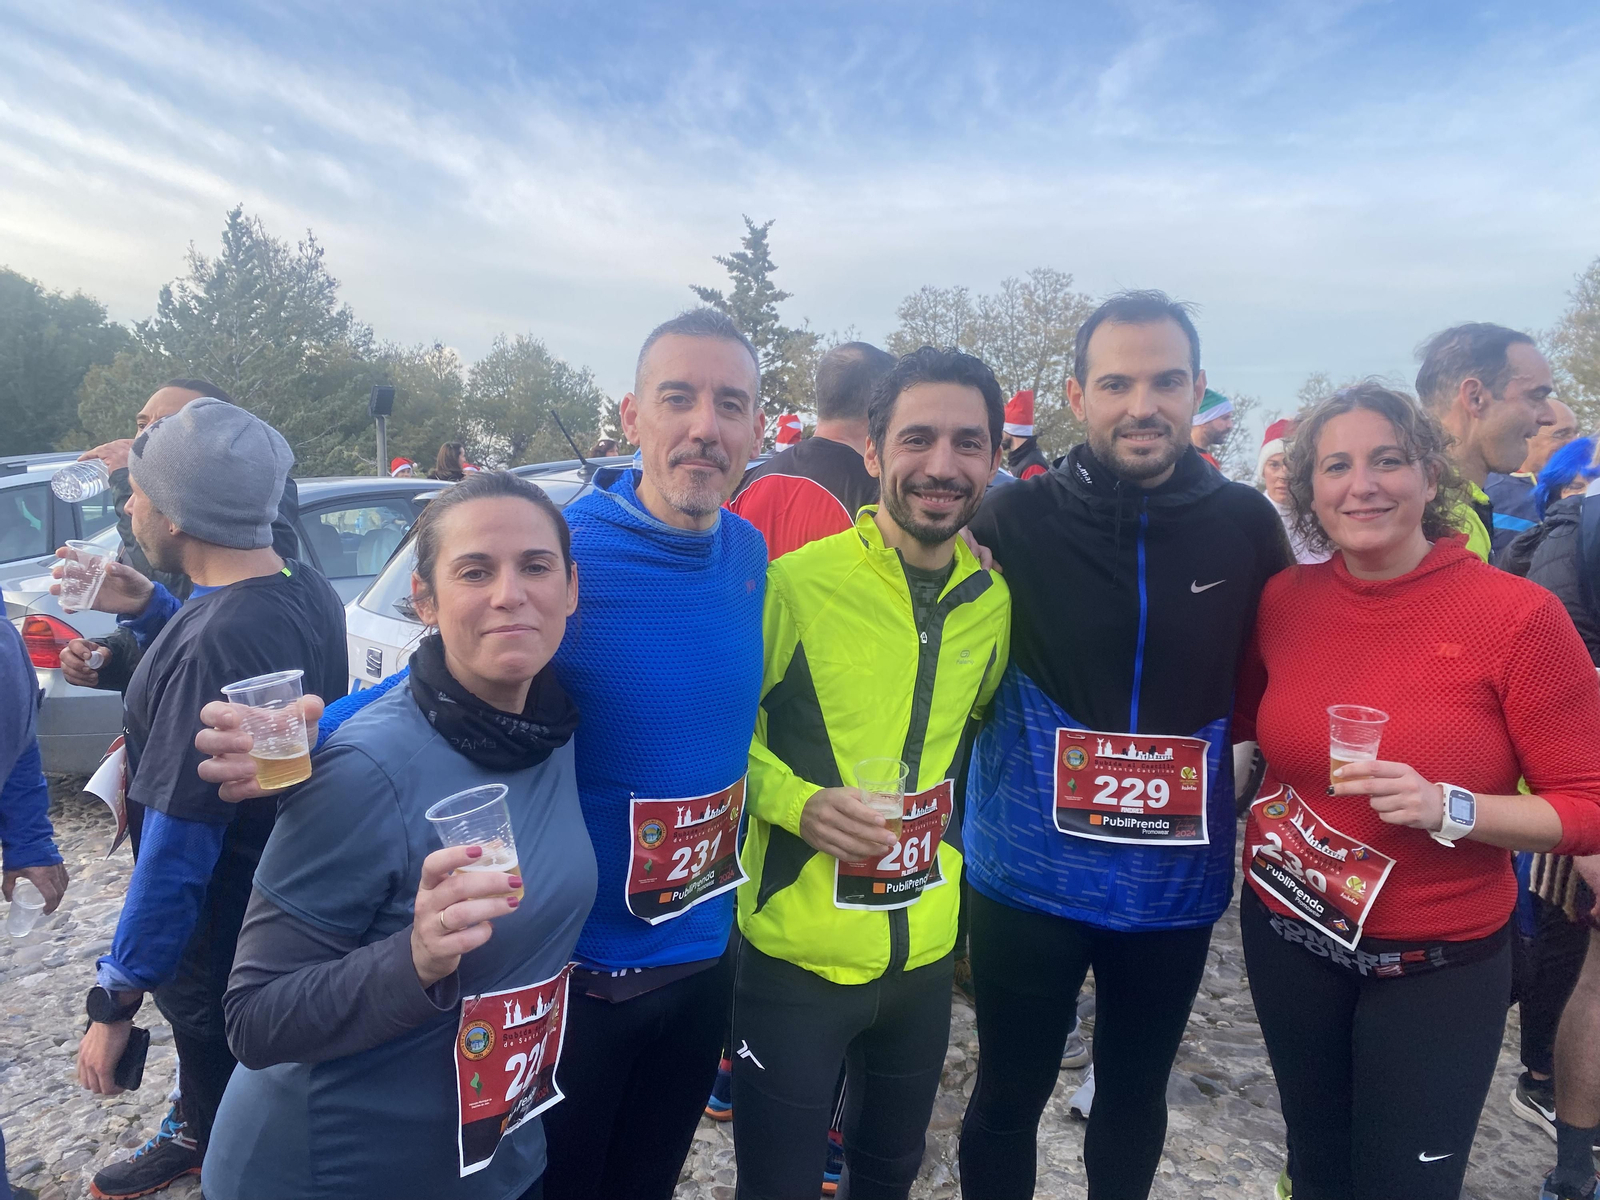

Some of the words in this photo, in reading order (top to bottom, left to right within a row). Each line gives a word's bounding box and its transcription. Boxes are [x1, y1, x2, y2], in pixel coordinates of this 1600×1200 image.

[1108, 765, 1133, 773] Santa
[1093, 775, 1170, 809] 229
[1102, 815, 1170, 829] PubliPrenda
[1175, 829, 1197, 838] 2024
[667, 830, 722, 881] 231
[876, 831, 931, 871] 261
[1260, 832, 1327, 893] 230
[672, 870, 715, 902] PubliPrenda
[718, 869, 735, 884] 2024
[886, 873, 930, 893] PubliPrend
[1266, 863, 1325, 914] PubliPrenda
[1295, 896, 1322, 918] Promowear
[502, 1029, 532, 1041] Subida
[519, 1032, 539, 1044] Santa
